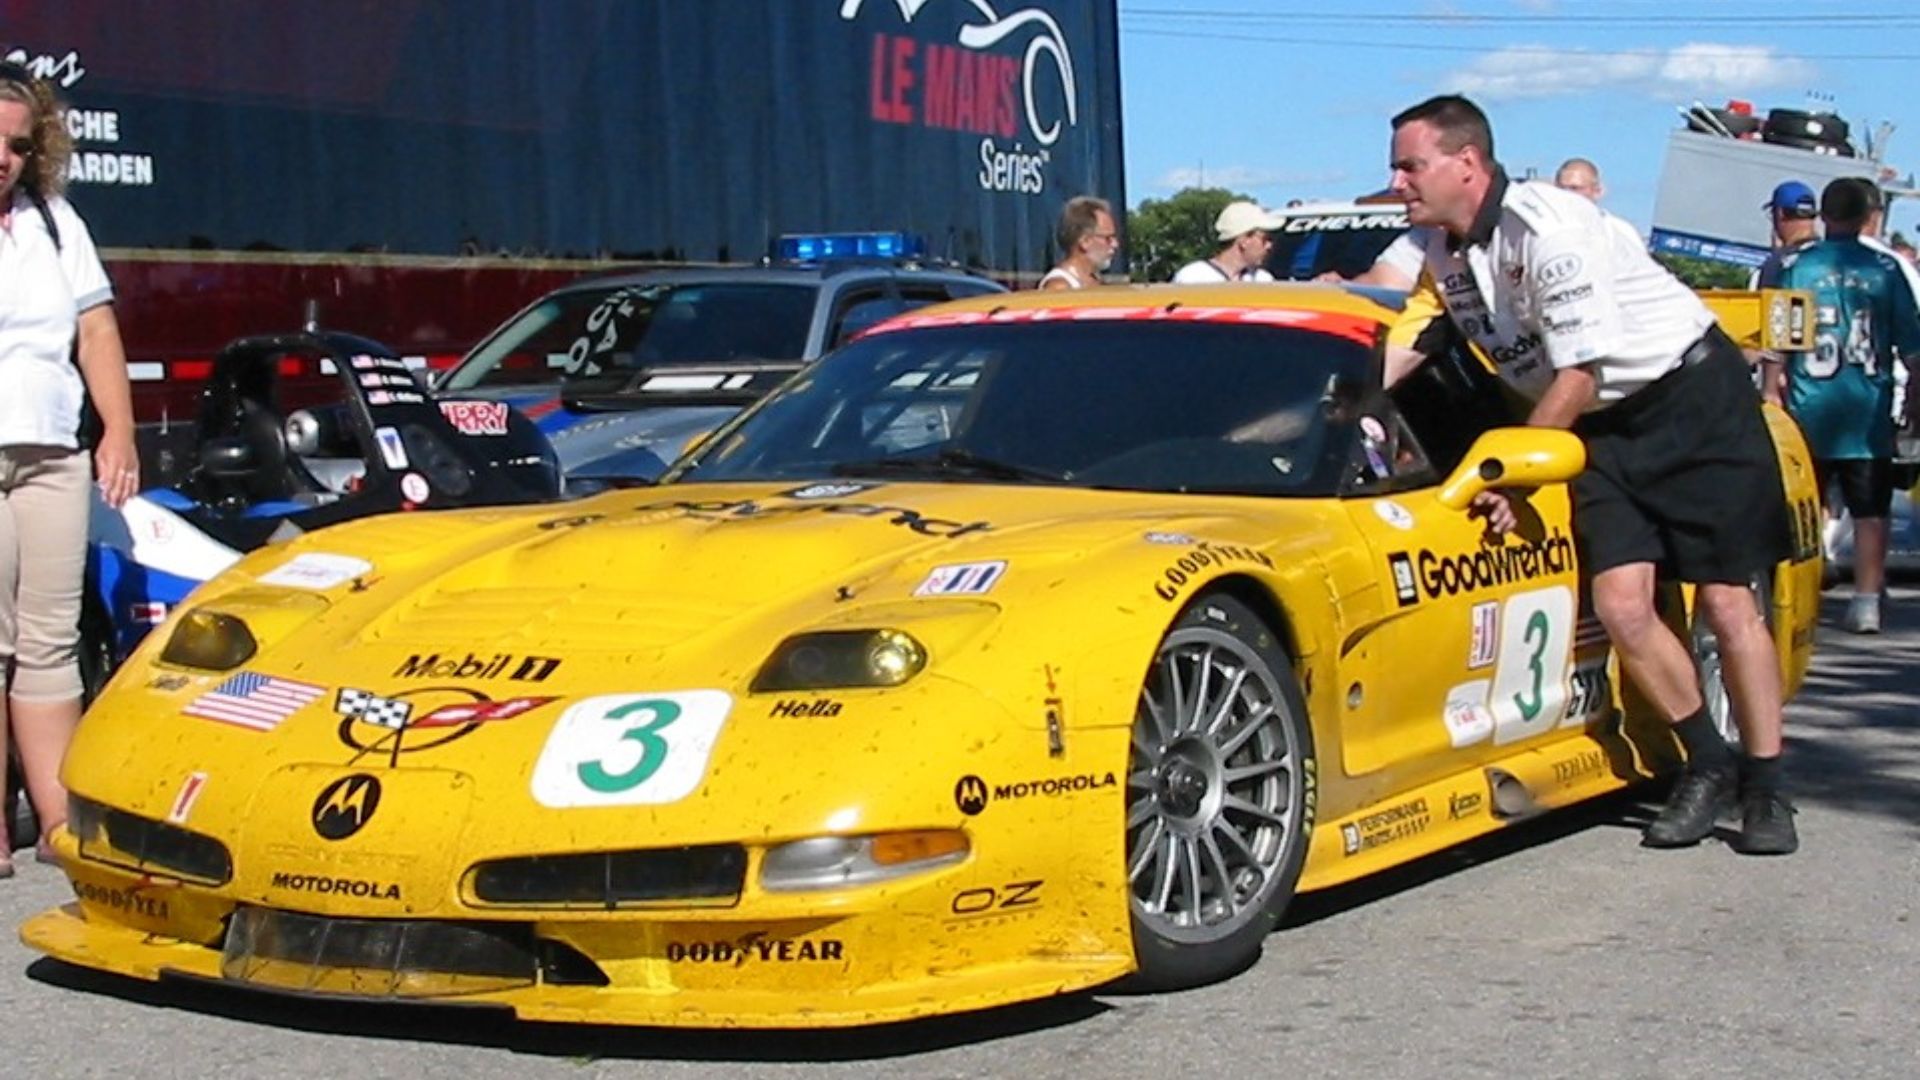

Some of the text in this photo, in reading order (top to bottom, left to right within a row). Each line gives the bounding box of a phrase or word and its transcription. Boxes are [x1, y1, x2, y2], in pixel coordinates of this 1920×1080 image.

[871, 32, 1018, 139] LE MANS
[58, 108, 119, 142] CHE
[60, 151, 154, 185] ARDEN
[394, 654, 508, 680] Mobil
[1512, 609, 1549, 722] 3
[769, 700, 844, 719] Hella
[577, 698, 682, 794] 3
[994, 772, 1118, 801] MOTOROLA
[271, 872, 402, 900] MOTOROLA
